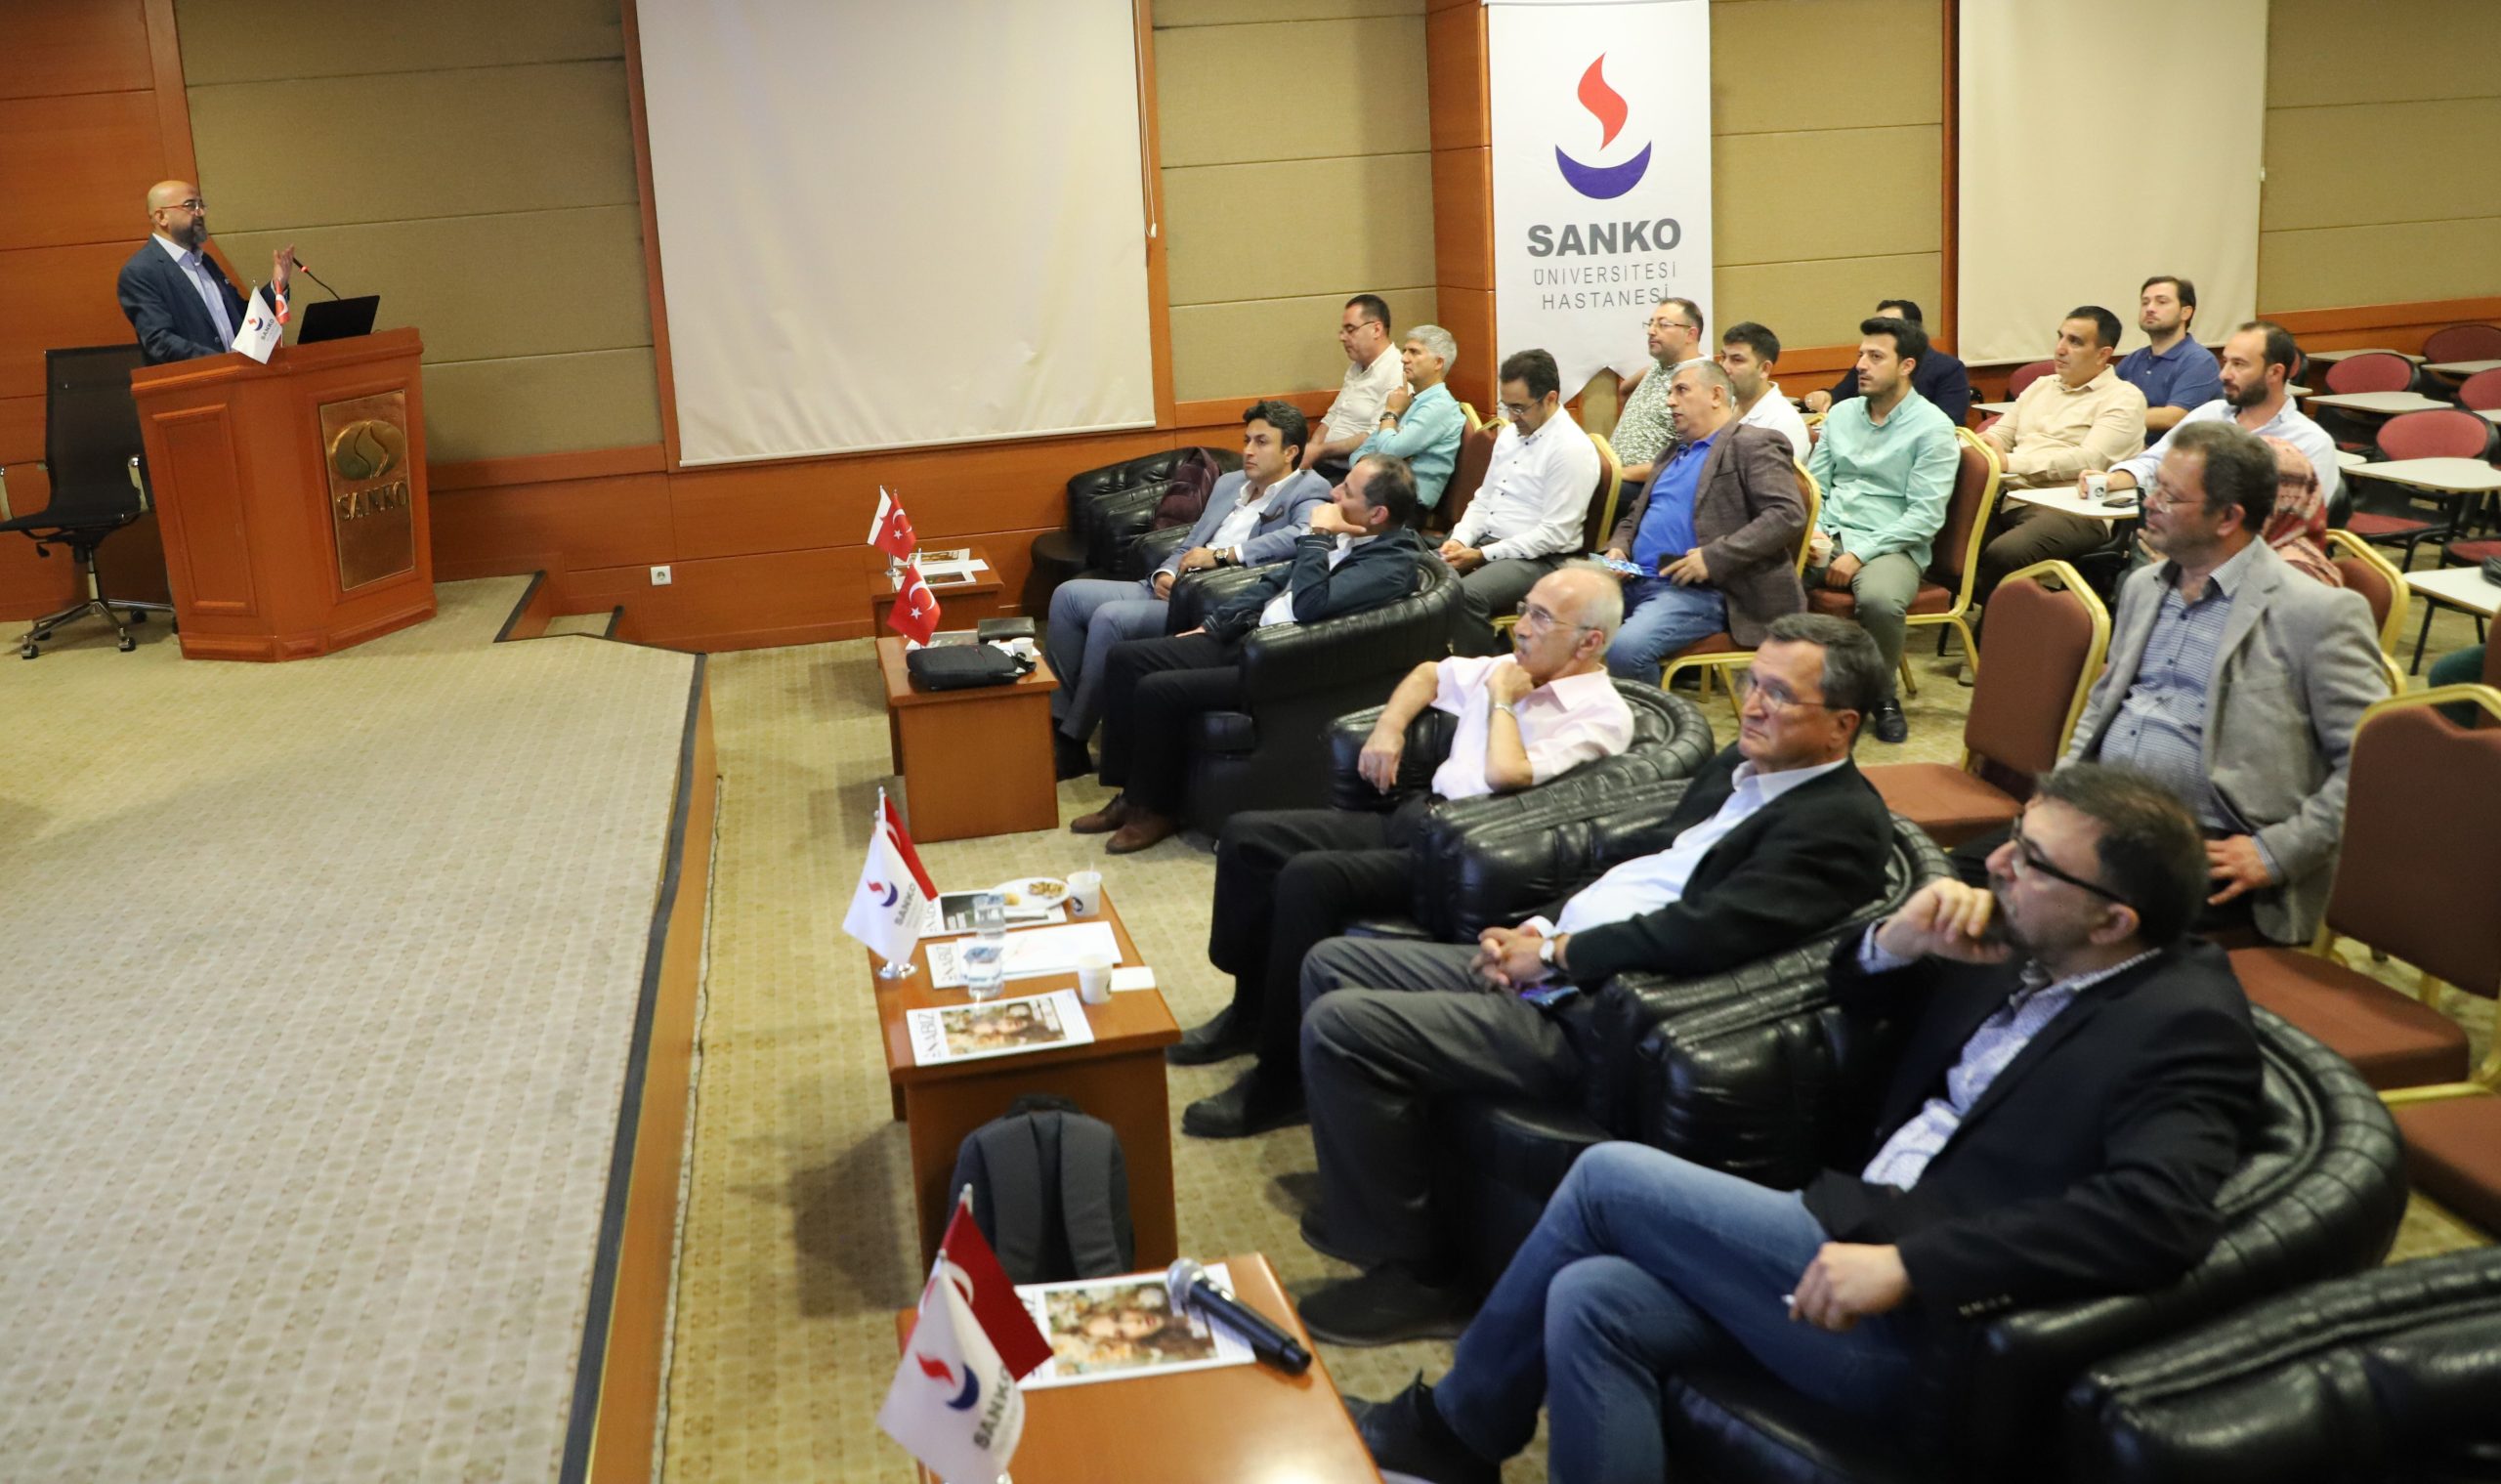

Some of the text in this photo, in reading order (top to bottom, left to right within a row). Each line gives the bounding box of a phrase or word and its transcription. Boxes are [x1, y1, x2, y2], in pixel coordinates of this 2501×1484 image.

[1527, 218, 1681, 257] SANKO
[1543, 283, 1668, 310] HASTANESİ
[336, 481, 407, 521] SANKO
[894, 882, 915, 926] SANKO
